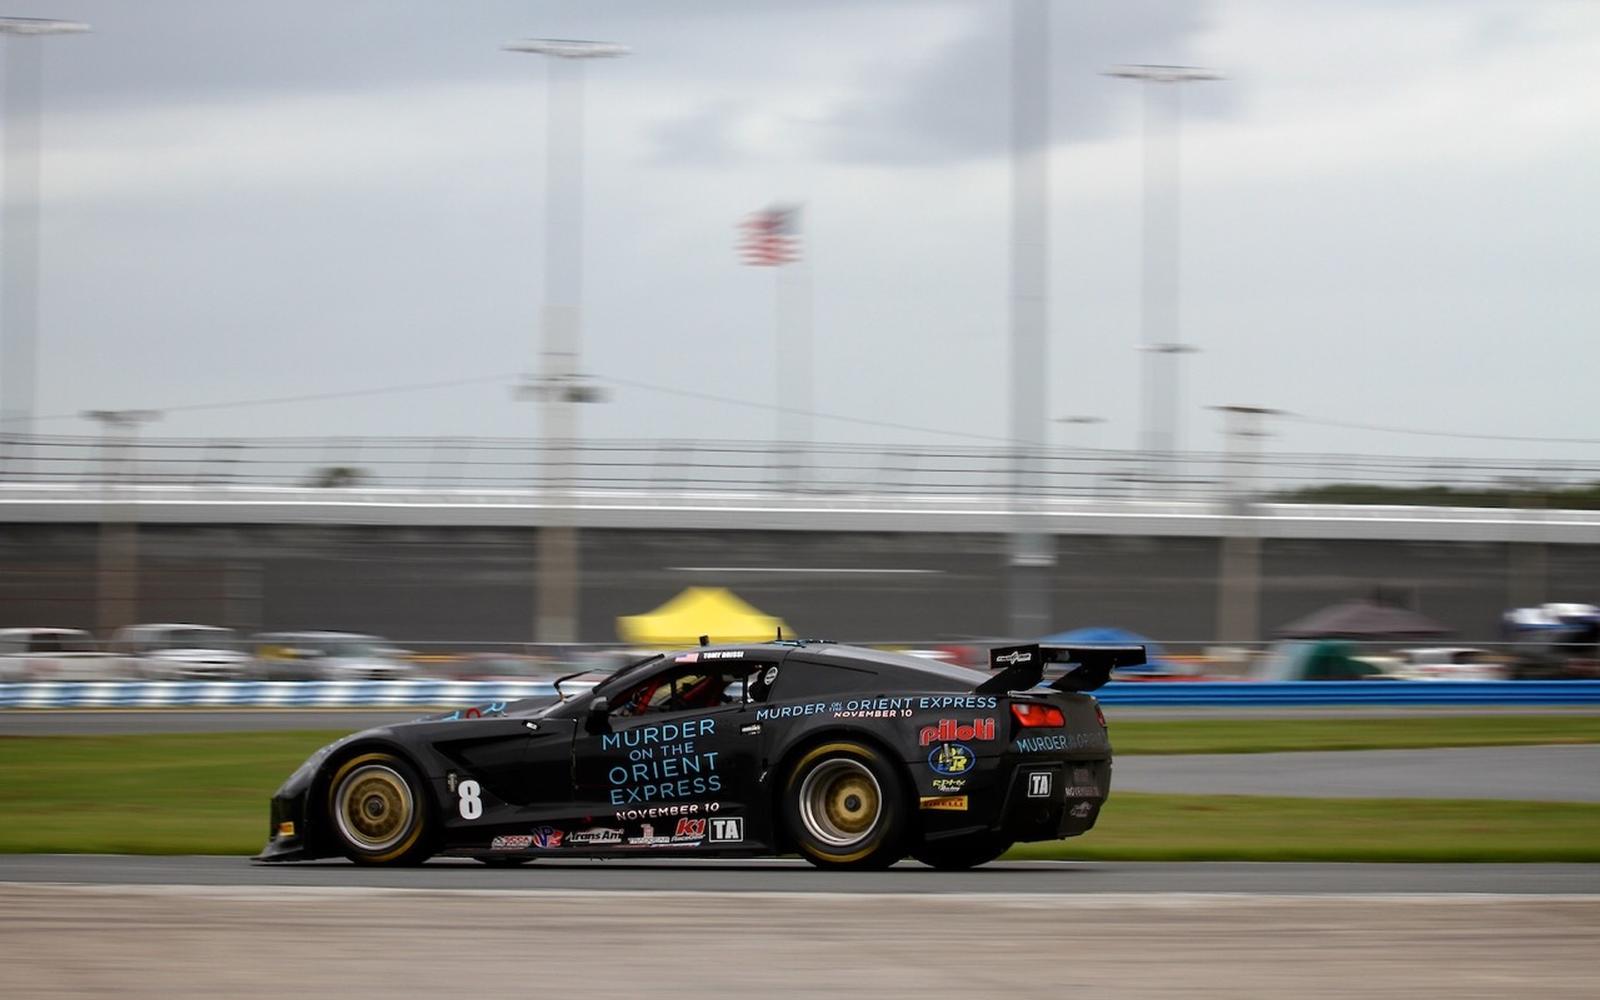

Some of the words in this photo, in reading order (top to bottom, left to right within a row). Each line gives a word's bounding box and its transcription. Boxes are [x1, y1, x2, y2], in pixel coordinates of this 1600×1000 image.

[756, 703, 825, 720] MURDER
[846, 698, 913, 711] ORIENT
[919, 696, 997, 709] EXPRESS
[833, 709, 897, 718] NOVEMBER
[900, 709, 913, 718] 10
[602, 718, 716, 751] MURDER
[918, 717, 996, 746] piloti
[629, 749, 653, 762] ON
[661, 741, 695, 755] THE
[1016, 735, 1068, 753] MURDER
[608, 752, 719, 785] ORIENT
[610, 775, 722, 806] EXPRESS
[1032, 775, 1049, 795] TA
[457, 780, 483, 820] 8
[615, 804, 699, 821] NOVEMBER
[704, 802, 720, 813] 10
[676, 817, 706, 837] K1
[713, 820, 739, 840] TA
